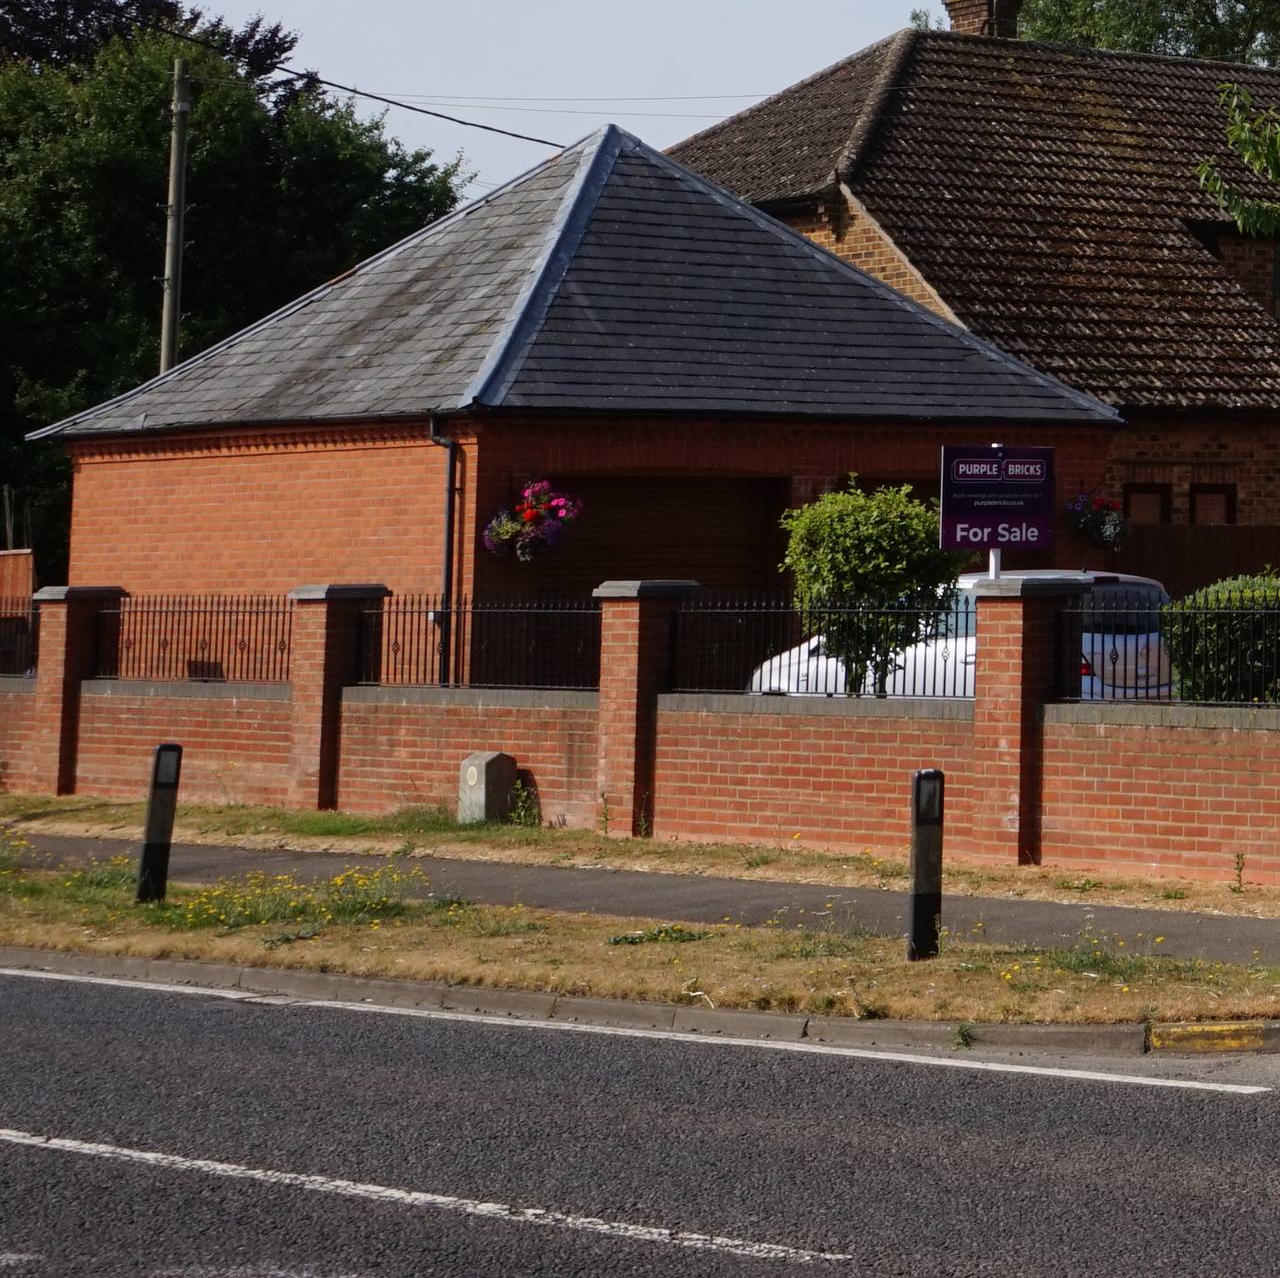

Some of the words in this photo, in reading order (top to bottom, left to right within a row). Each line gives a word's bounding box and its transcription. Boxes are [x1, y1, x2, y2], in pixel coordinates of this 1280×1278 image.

[958, 464, 998, 475] PURPLE
[1008, 464, 1041, 476] BRICKS
[956, 523, 991, 542] For
[997, 522, 1039, 542] Sale
